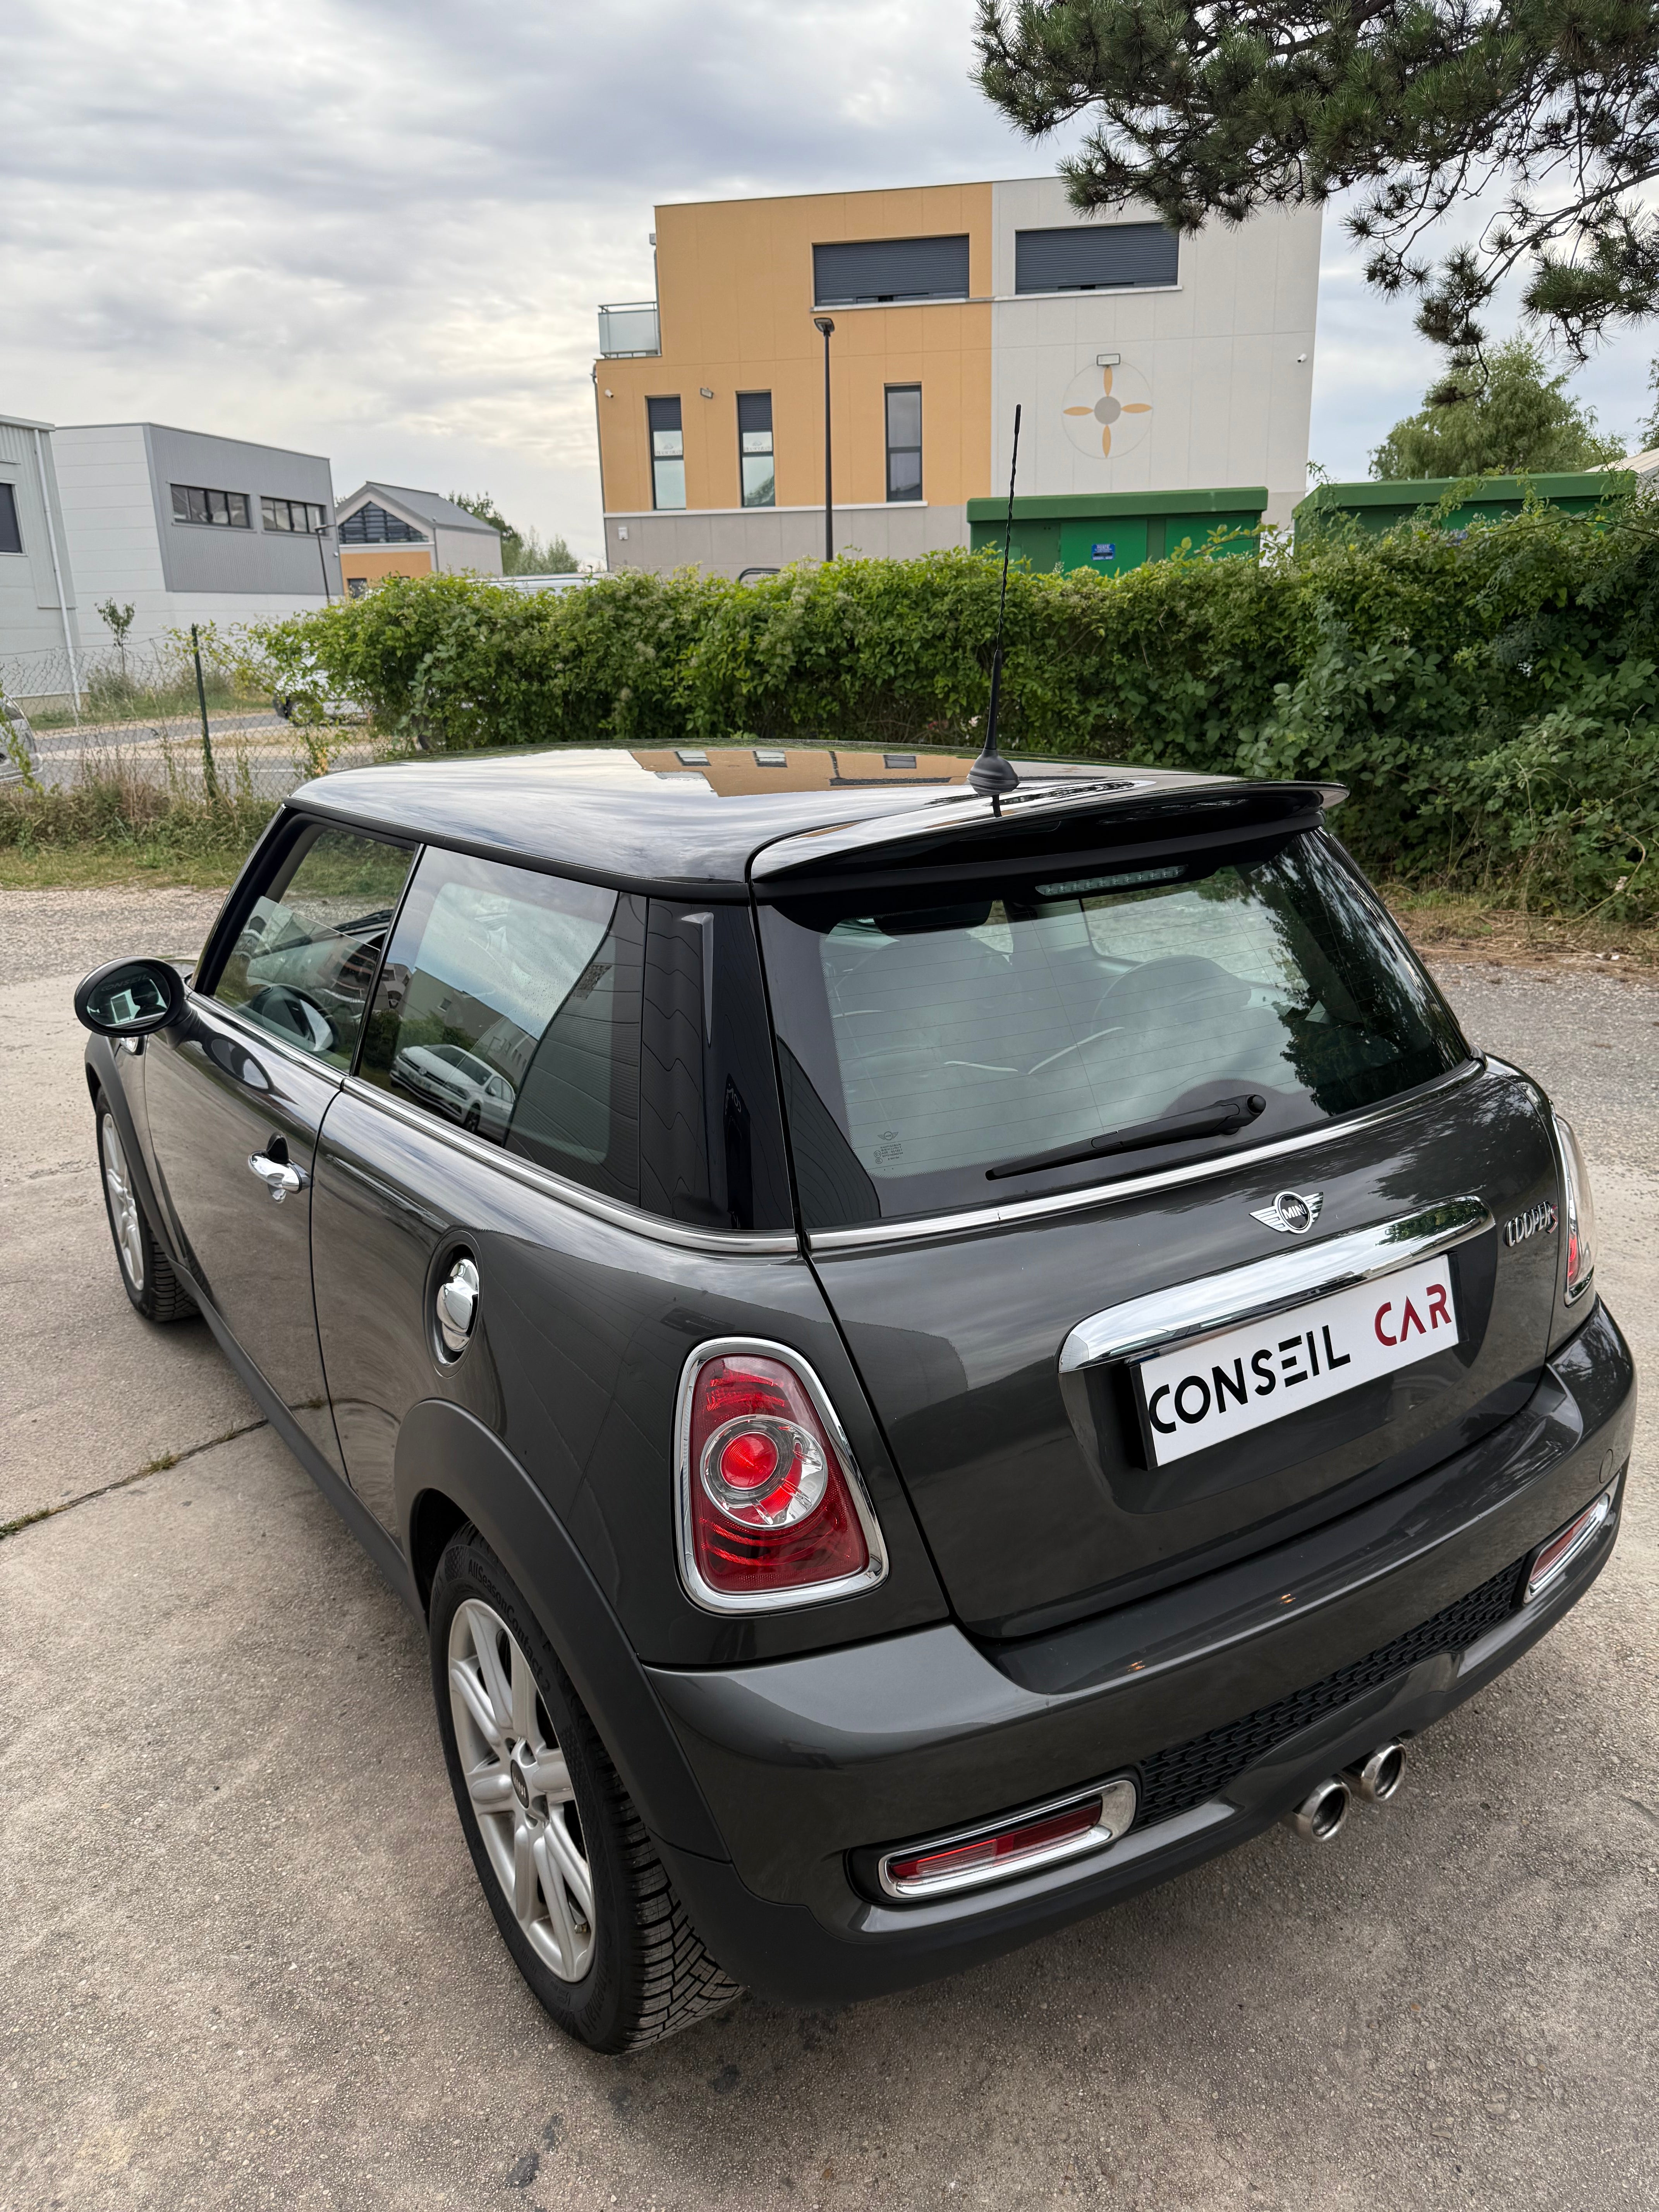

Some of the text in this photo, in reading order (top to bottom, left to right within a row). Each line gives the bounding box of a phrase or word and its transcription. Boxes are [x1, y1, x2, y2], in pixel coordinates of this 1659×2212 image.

[1282, 1204, 1307, 1220] MINI
[1506, 1200, 1558, 1247] COOPER S
[1148, 1284, 1452, 1434] CONSEIL CAR
[468, 1559, 543, 1678] AllSeasonContact
